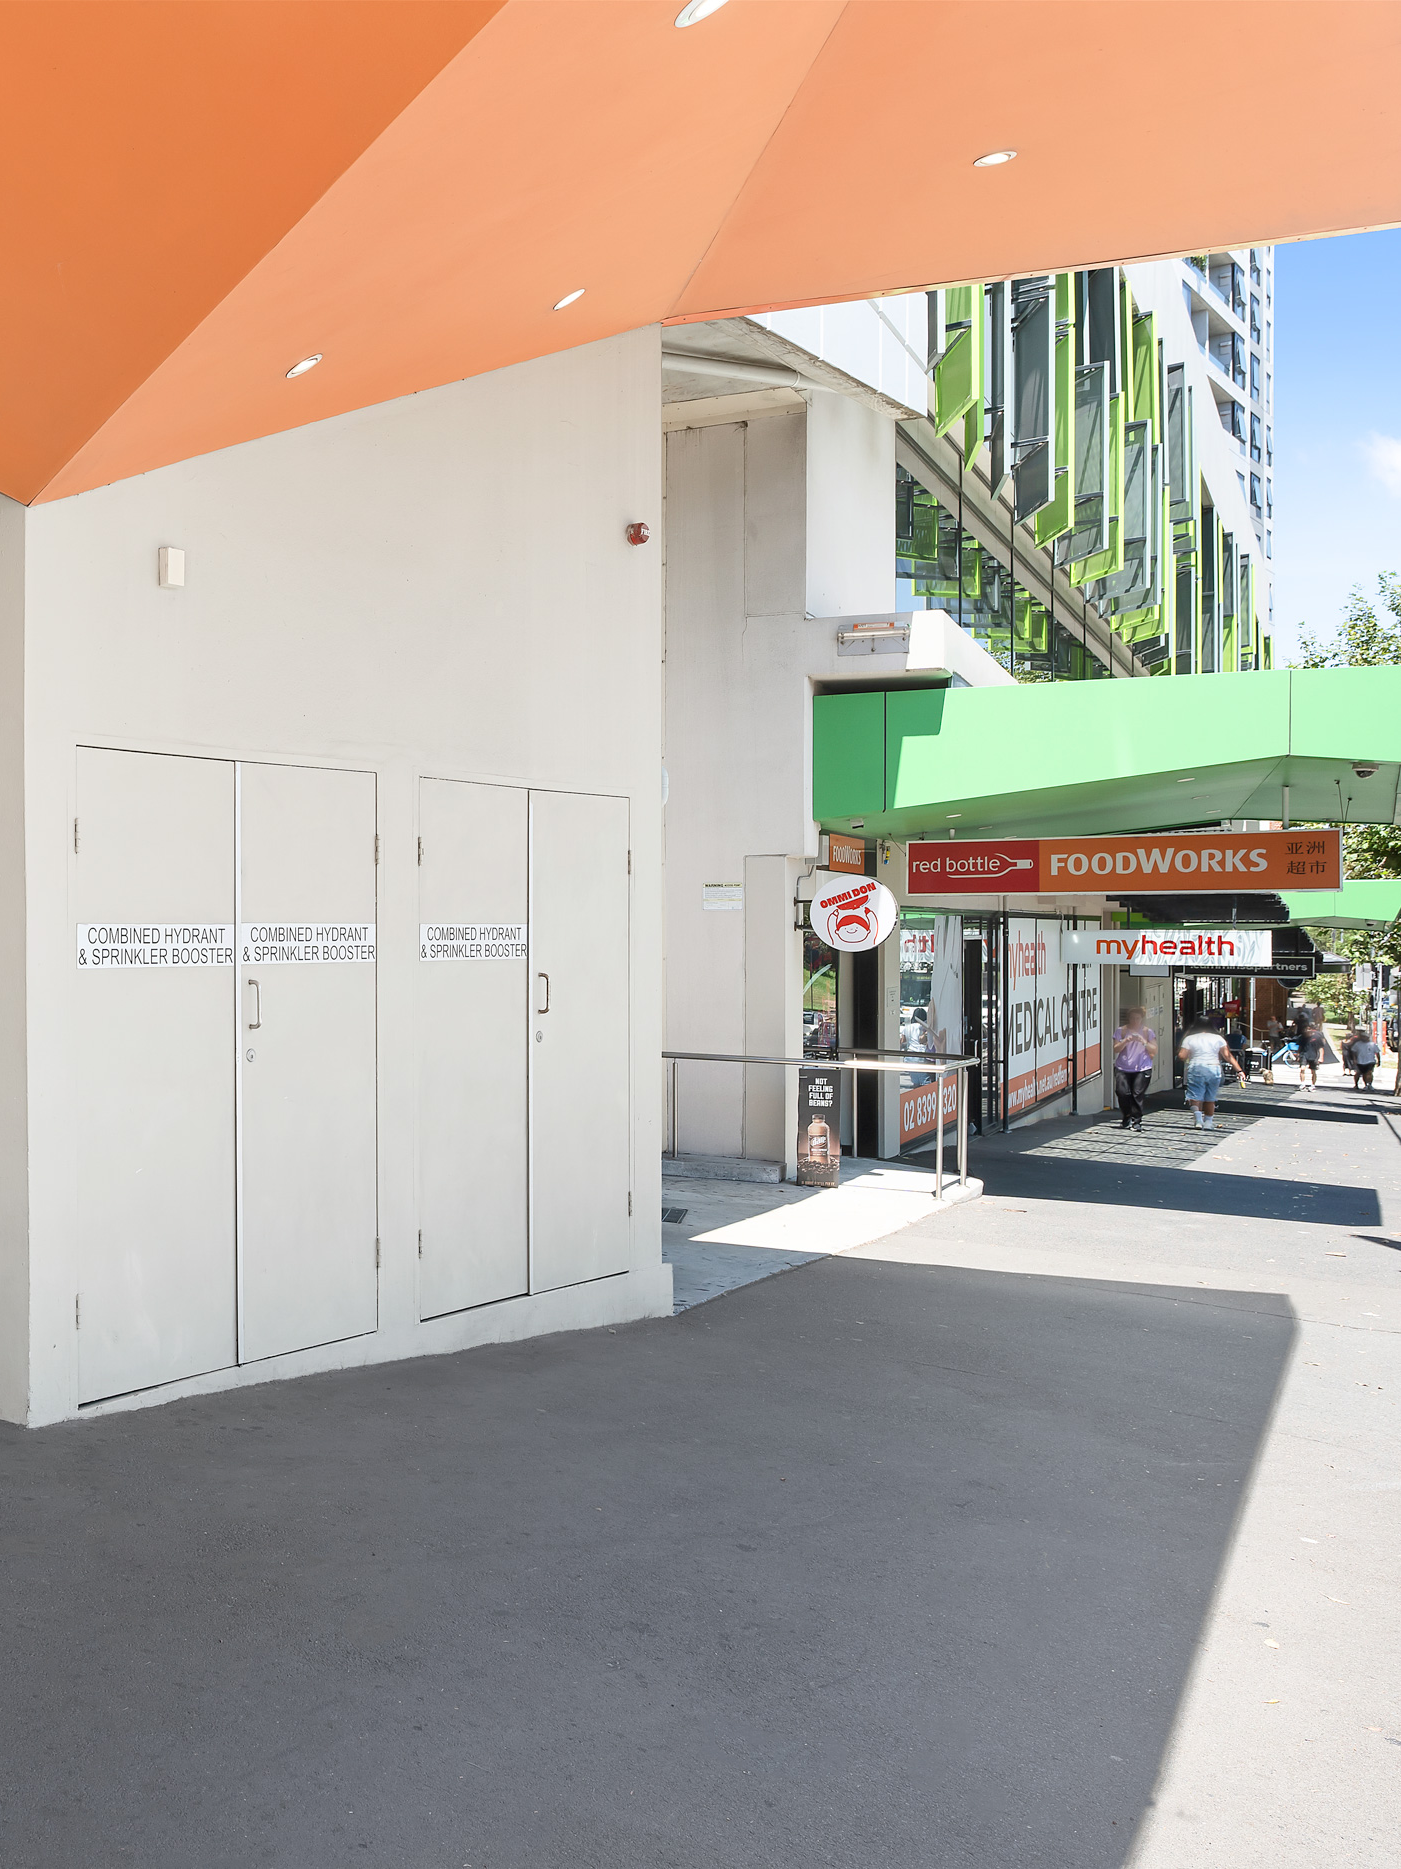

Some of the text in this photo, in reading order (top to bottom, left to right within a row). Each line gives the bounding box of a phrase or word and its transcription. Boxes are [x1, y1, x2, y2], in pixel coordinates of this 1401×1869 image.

[1285, 841, 1325, 855] 亚洲
[912, 856, 1001, 873] red bottle
[1286, 860, 1327, 875] 超市
[820, 882, 877, 909] OMMI DON
[87, 927, 226, 944] COMBINED HYDRANT
[250, 926, 369, 942] COMBINED HYDRANT
[427, 926, 522, 941] COMBINED HYDRANT
[242, 945, 376, 962] & SPRINKLER BOOSTER
[420, 943, 527, 958] & SPRINKLER BOOSTER
[1096, 934, 1235, 960] myhealth
[78, 947, 233, 965] & SPRINKLER BOOSTER
[1009, 929, 1046, 991] yheath
[808, 1085, 833, 1093] FEELING
[809, 1092, 824, 1100] FULL
[903, 1083, 957, 1132] 02 8399 320
